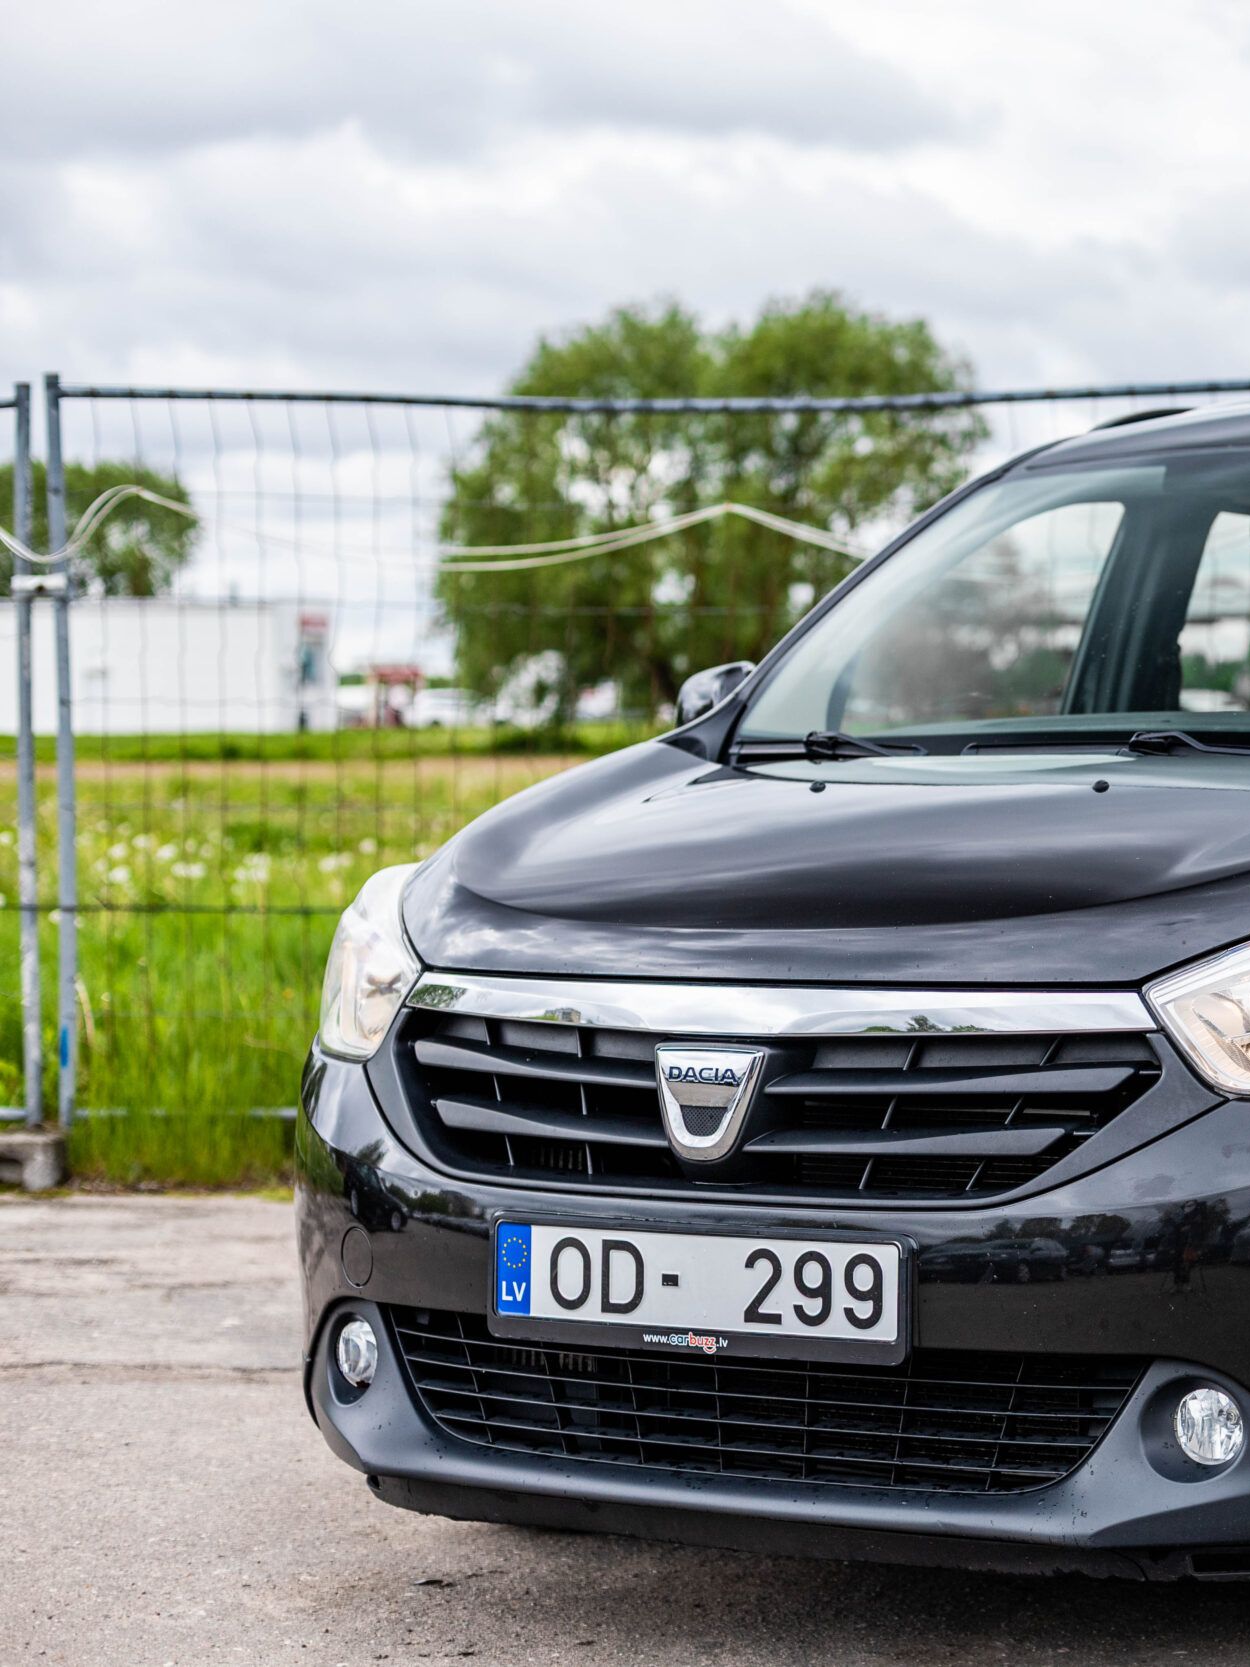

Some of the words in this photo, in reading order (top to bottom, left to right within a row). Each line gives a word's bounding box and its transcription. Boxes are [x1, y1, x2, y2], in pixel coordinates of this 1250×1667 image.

[668, 1066, 739, 1086] DACIA
[501, 1280, 527, 1302] LV
[743, 1248, 883, 1329] 299
[643, 1331, 728, 1352] www.carbuzz.lv
